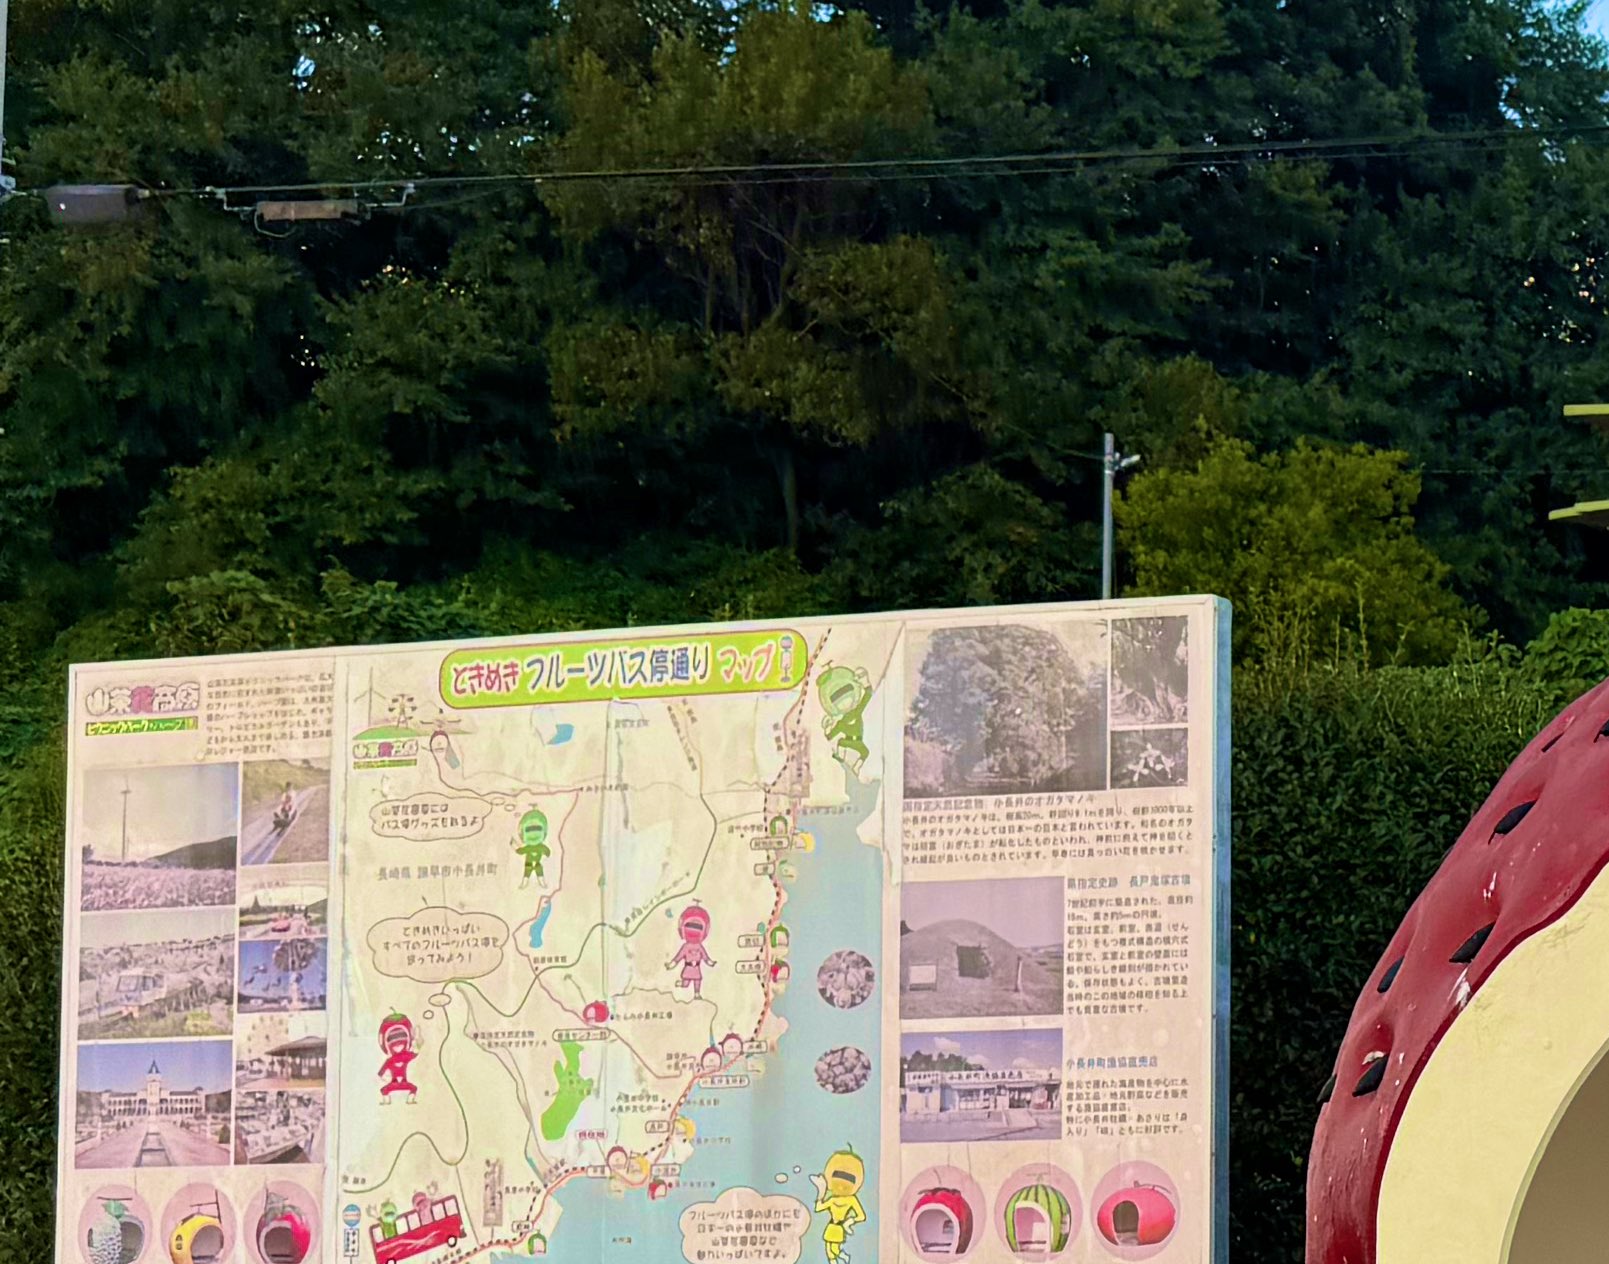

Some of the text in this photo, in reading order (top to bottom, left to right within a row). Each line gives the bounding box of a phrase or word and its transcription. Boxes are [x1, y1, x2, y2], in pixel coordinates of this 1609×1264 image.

[453, 645, 775, 696] ときめき フルーツバス停通り マップ
[378, 866, 411, 881] 長崎県
